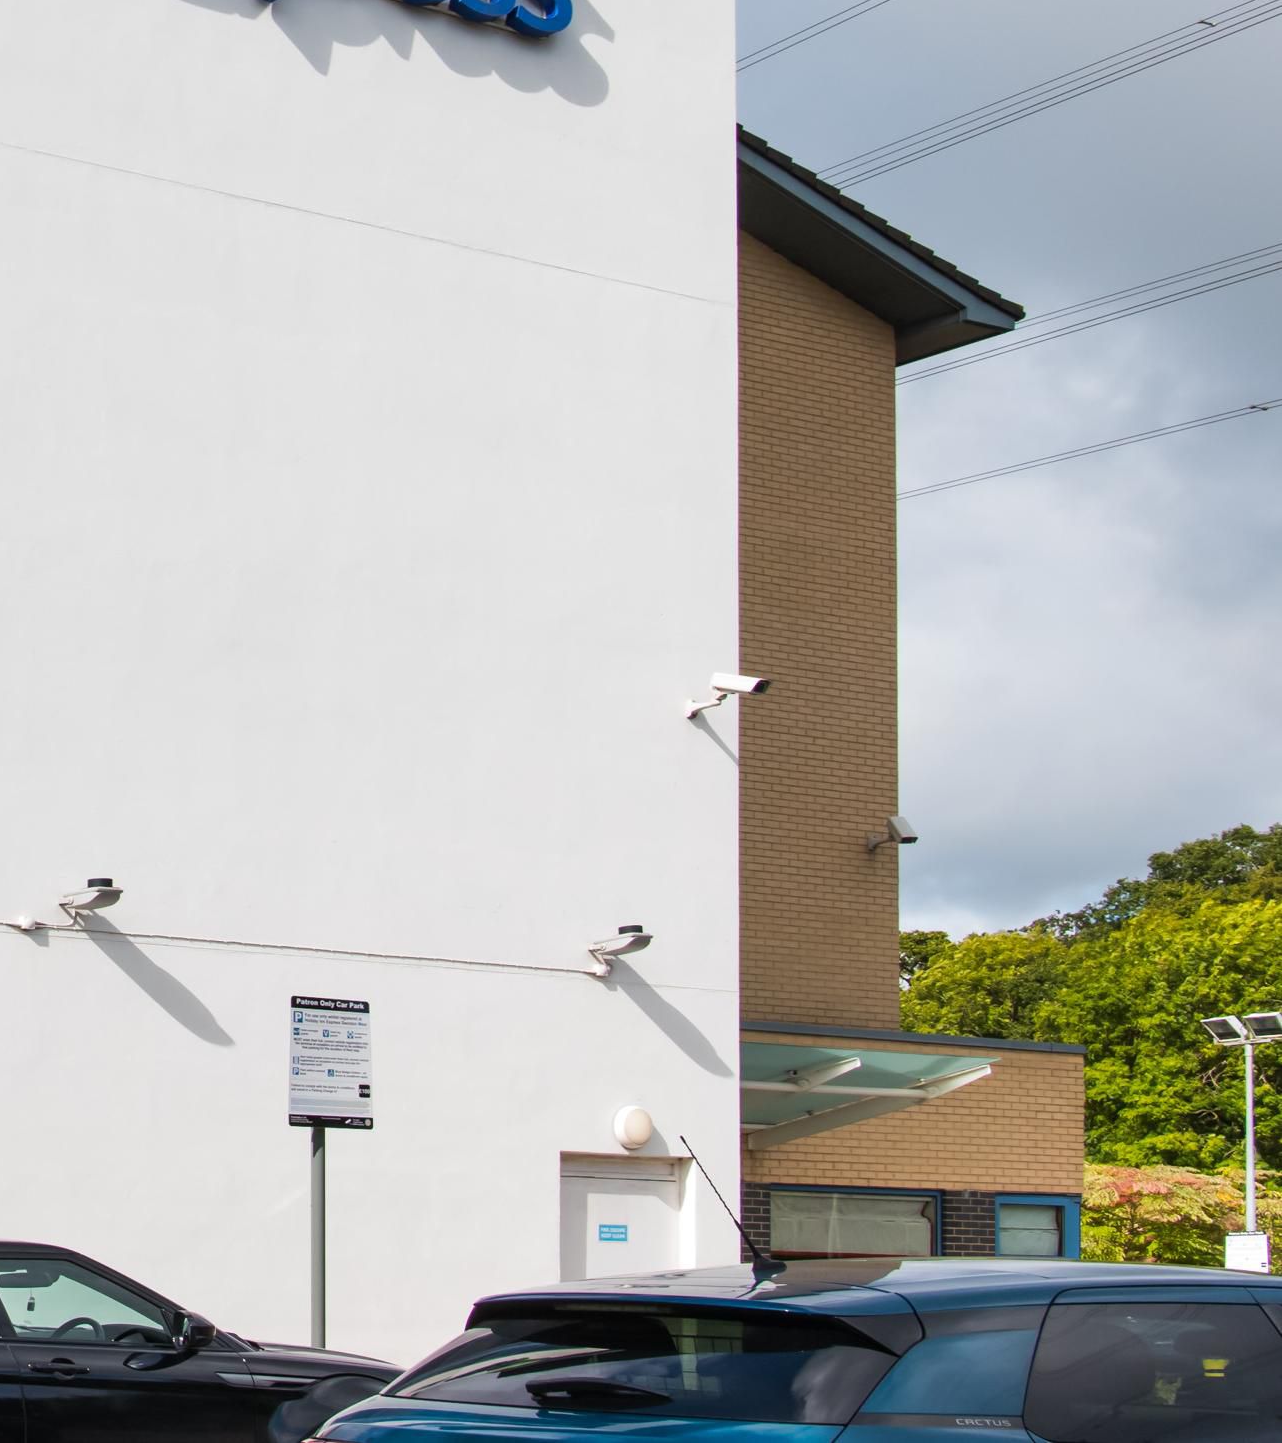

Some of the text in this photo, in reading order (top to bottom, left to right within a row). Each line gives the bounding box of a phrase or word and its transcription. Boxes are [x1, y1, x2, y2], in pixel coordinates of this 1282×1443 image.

[295, 998, 319, 1006] Patron
[319, 1000, 335, 1009] Only
[955, 1418, 1012, 1427] CACTUS
